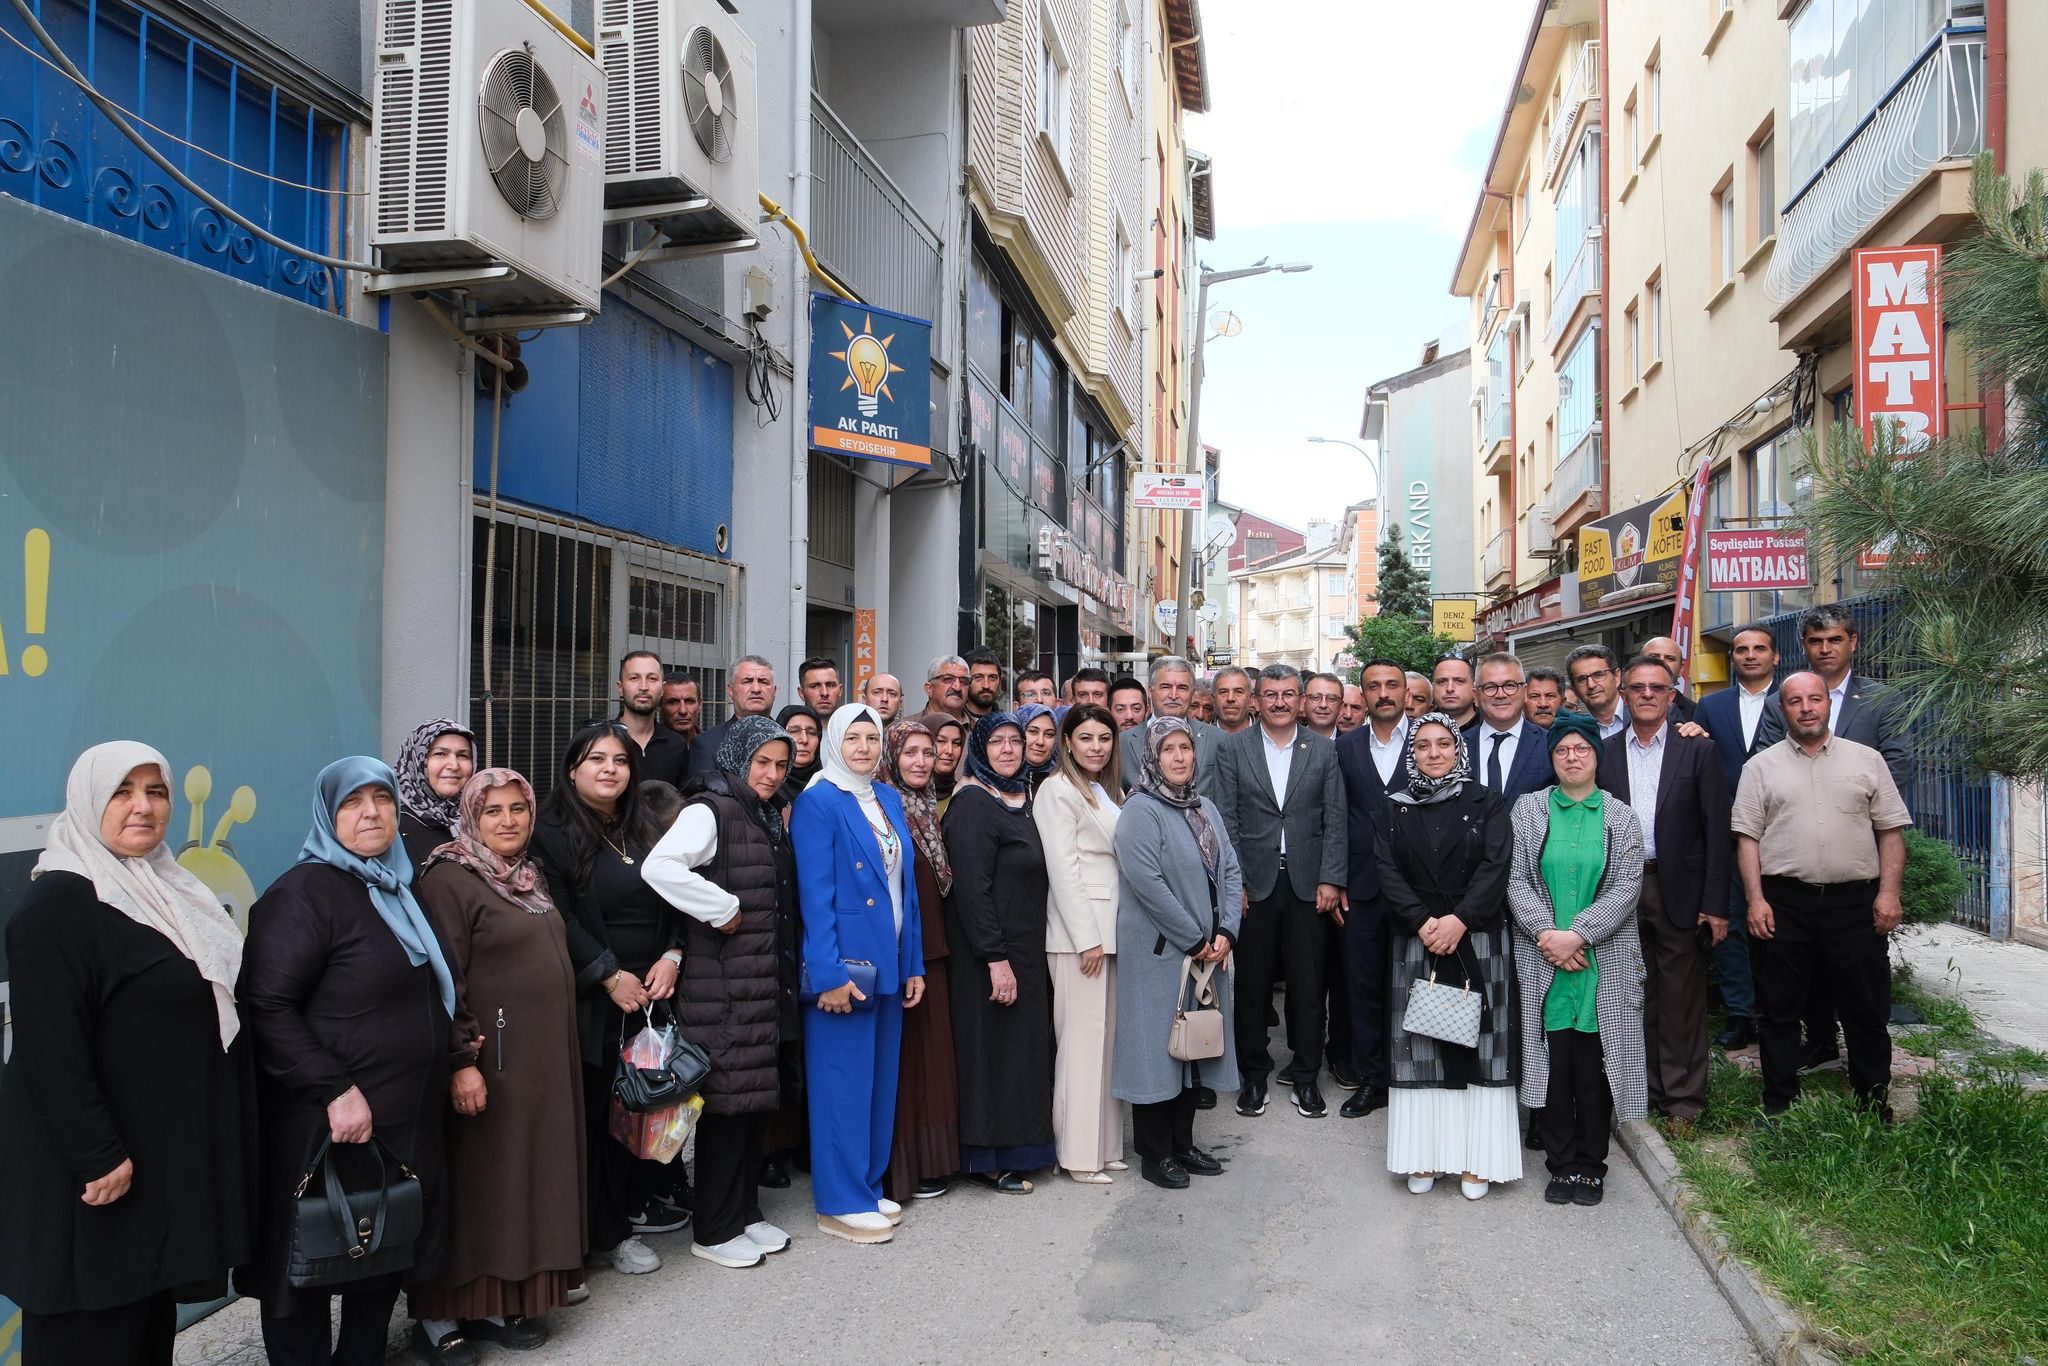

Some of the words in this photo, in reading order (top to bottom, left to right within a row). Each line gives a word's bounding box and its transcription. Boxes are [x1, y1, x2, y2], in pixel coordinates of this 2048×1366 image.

[837, 416, 858, 432] AK
[839, 437, 897, 457] SEYDİŞEHİR
[1658, 512, 1682, 534] TO
[1584, 539, 1602, 557] FAST
[1653, 533, 1682, 556] KÖFTE
[1710, 537, 1764, 552] Seydişehir
[1583, 556, 1605, 575] FOOD
[1443, 621, 1465, 630] TEKEL
[857, 632, 872, 659] AK
